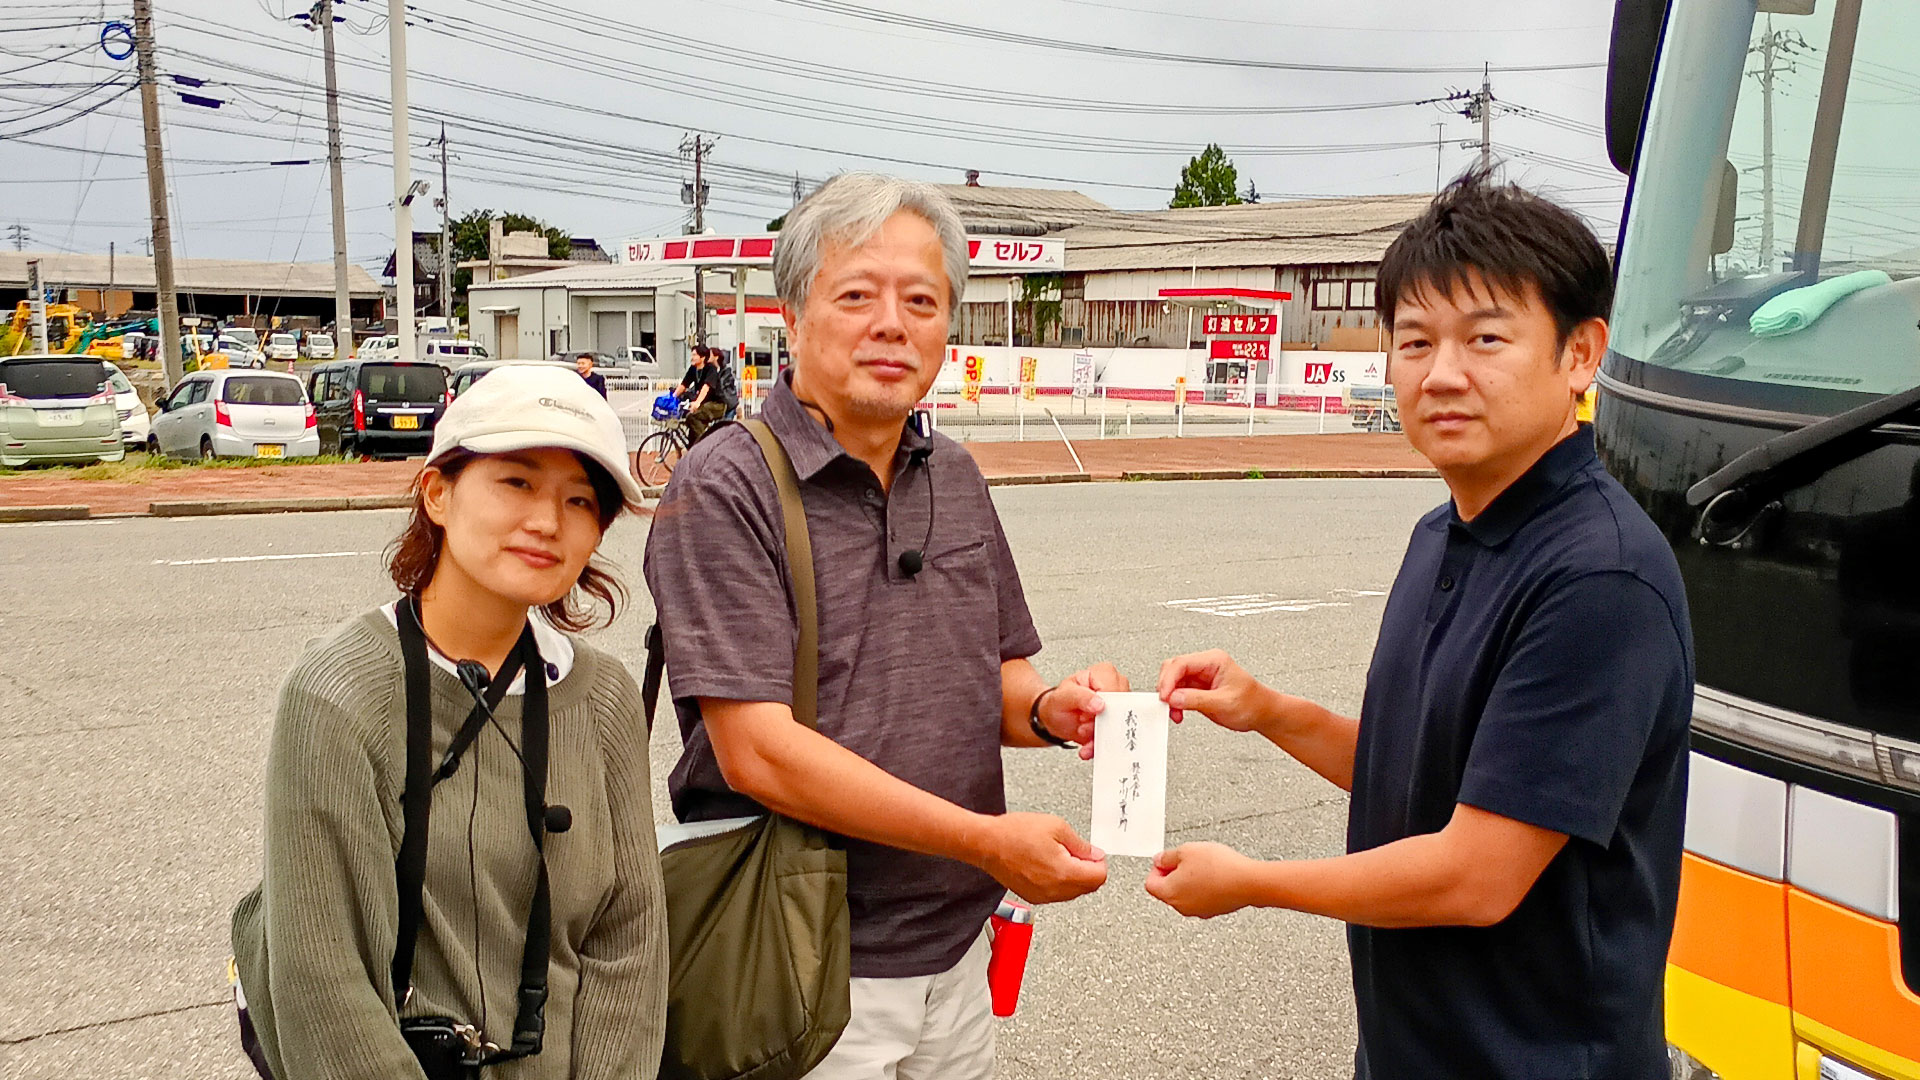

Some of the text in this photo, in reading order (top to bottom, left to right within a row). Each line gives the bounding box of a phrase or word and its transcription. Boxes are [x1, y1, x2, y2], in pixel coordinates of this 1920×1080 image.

[629, 244, 650, 262] セルフ
[994, 242, 1044, 262] セルフ
[1207, 316, 1270, 333] 灯油セルフ
[966, 356, 978, 402] OPEN
[1306, 364, 1346, 383] JA SS
